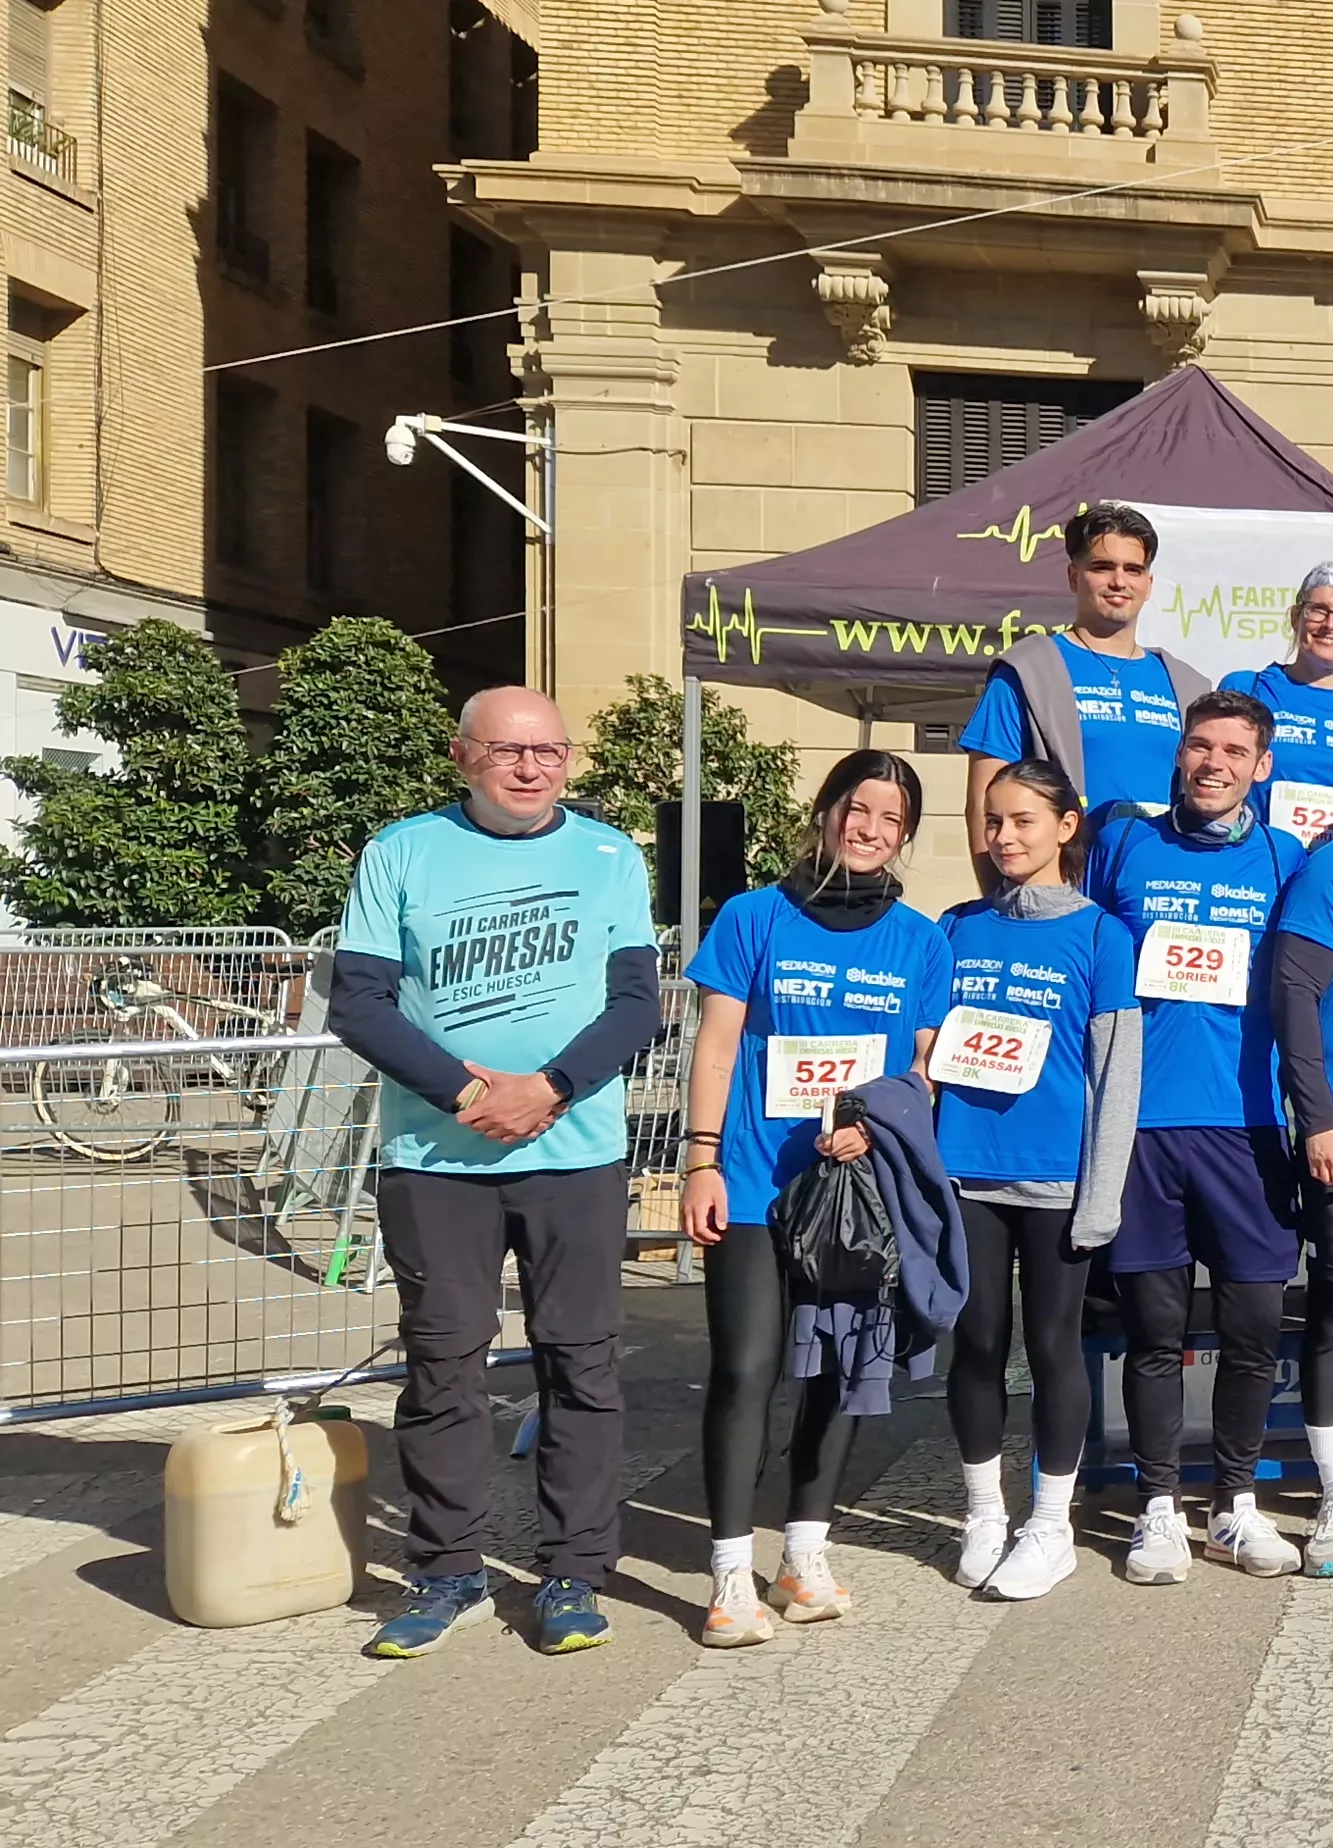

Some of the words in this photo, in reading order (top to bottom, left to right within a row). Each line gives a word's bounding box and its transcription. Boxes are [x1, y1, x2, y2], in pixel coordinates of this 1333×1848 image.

[1076, 700, 1124, 715] NEXT
[1273, 711, 1316, 726] EDIAZION
[1145, 880, 1202, 892] MEDIAZION
[1225, 884, 1267, 903] kablex
[1143, 896, 1200, 914] NEXT
[449, 916, 473, 939] III
[477, 905, 550, 933] CARRERA
[430, 920, 579, 991] EMPRESAS
[956, 958, 1003, 970] MEDIAZION
[1165, 944, 1224, 971] 529
[776, 960, 837, 976] MEDIAZION
[1024, 963, 1067, 985] kablex
[1168, 970, 1218, 983] LORIEN
[453, 984, 482, 1002] ESIC
[487, 971, 541, 994] HUESCA
[861, 969, 906, 988] kablex
[953, 976, 1000, 993] NEXT
[1169, 981, 1190, 993] 8K
[774, 979, 834, 998] NEXT
[844, 992, 886, 1006] HOME
[963, 1032, 1023, 1061] 422
[795, 1059, 857, 1083] 527
[951, 1054, 1024, 1074] HADASSAH
[962, 1067, 982, 1080] 8K
[1270, 1359, 1302, 1404] 2
